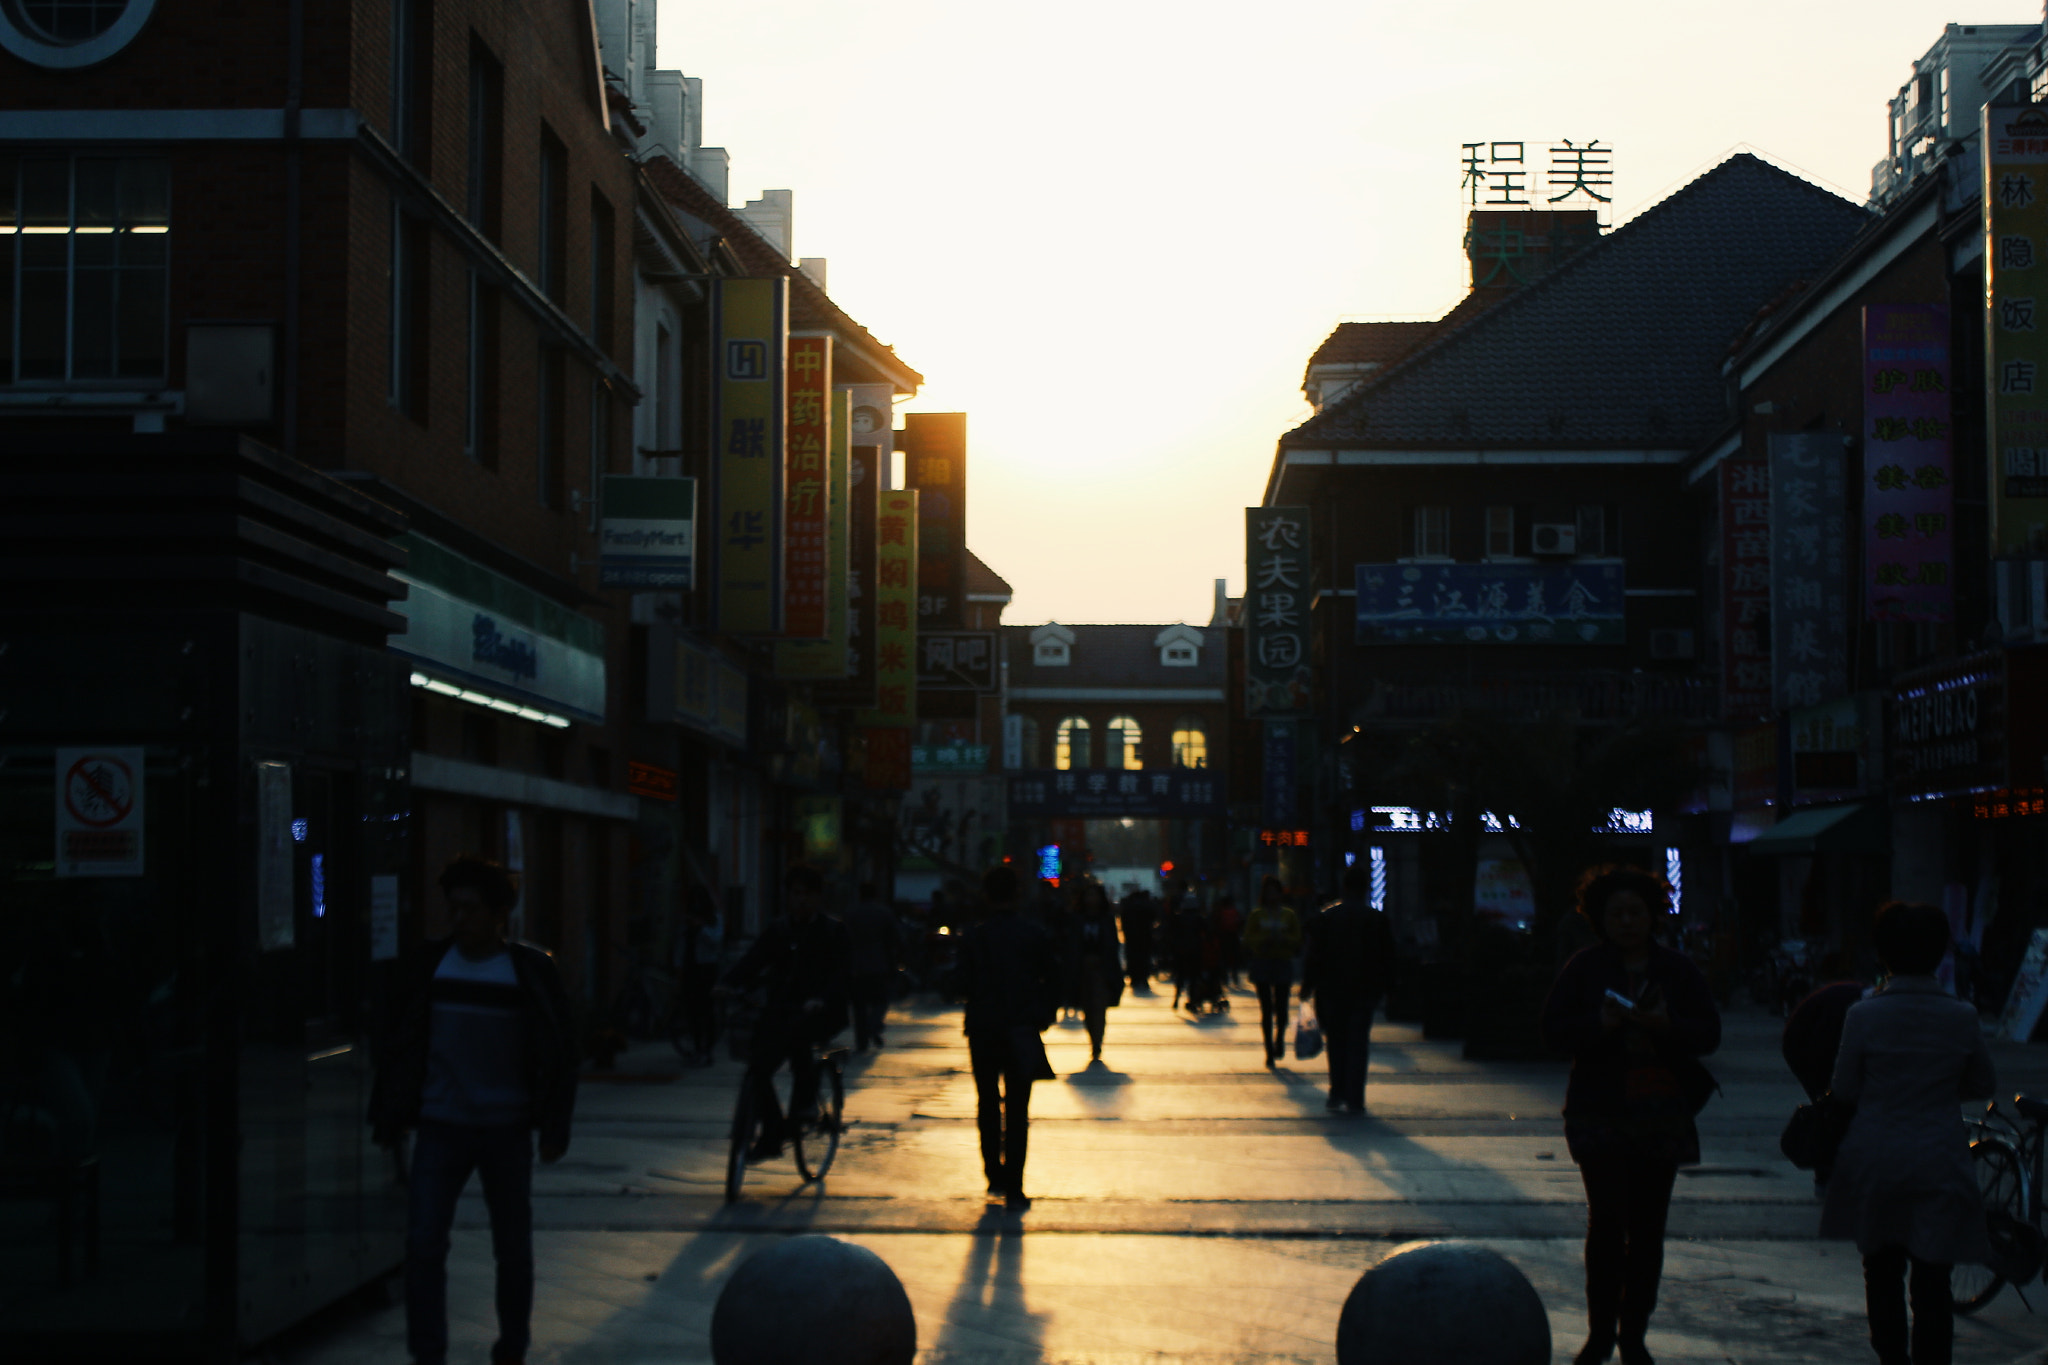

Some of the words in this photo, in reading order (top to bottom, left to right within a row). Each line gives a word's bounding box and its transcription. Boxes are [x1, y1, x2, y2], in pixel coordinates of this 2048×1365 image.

[1462, 138, 1613, 206] 程美
[2000, 172, 2034, 394] 林隐饭店
[1872, 369, 1947, 394] 护肤
[791, 342, 823, 517] 中药治疗
[1872, 416, 1949, 442] 彩妆
[728, 417, 765, 550] 联华
[1873, 464, 1949, 490] 美容
[603, 528, 685, 548] FamilyMart
[1875, 513, 1947, 540] 美甲
[877, 515, 908, 716] 黄焖鸡米饭
[1256, 516, 1301, 669] 农夫果园
[1395, 578, 1601, 625] 三江源美食
[925, 637, 988, 672] 网吧
